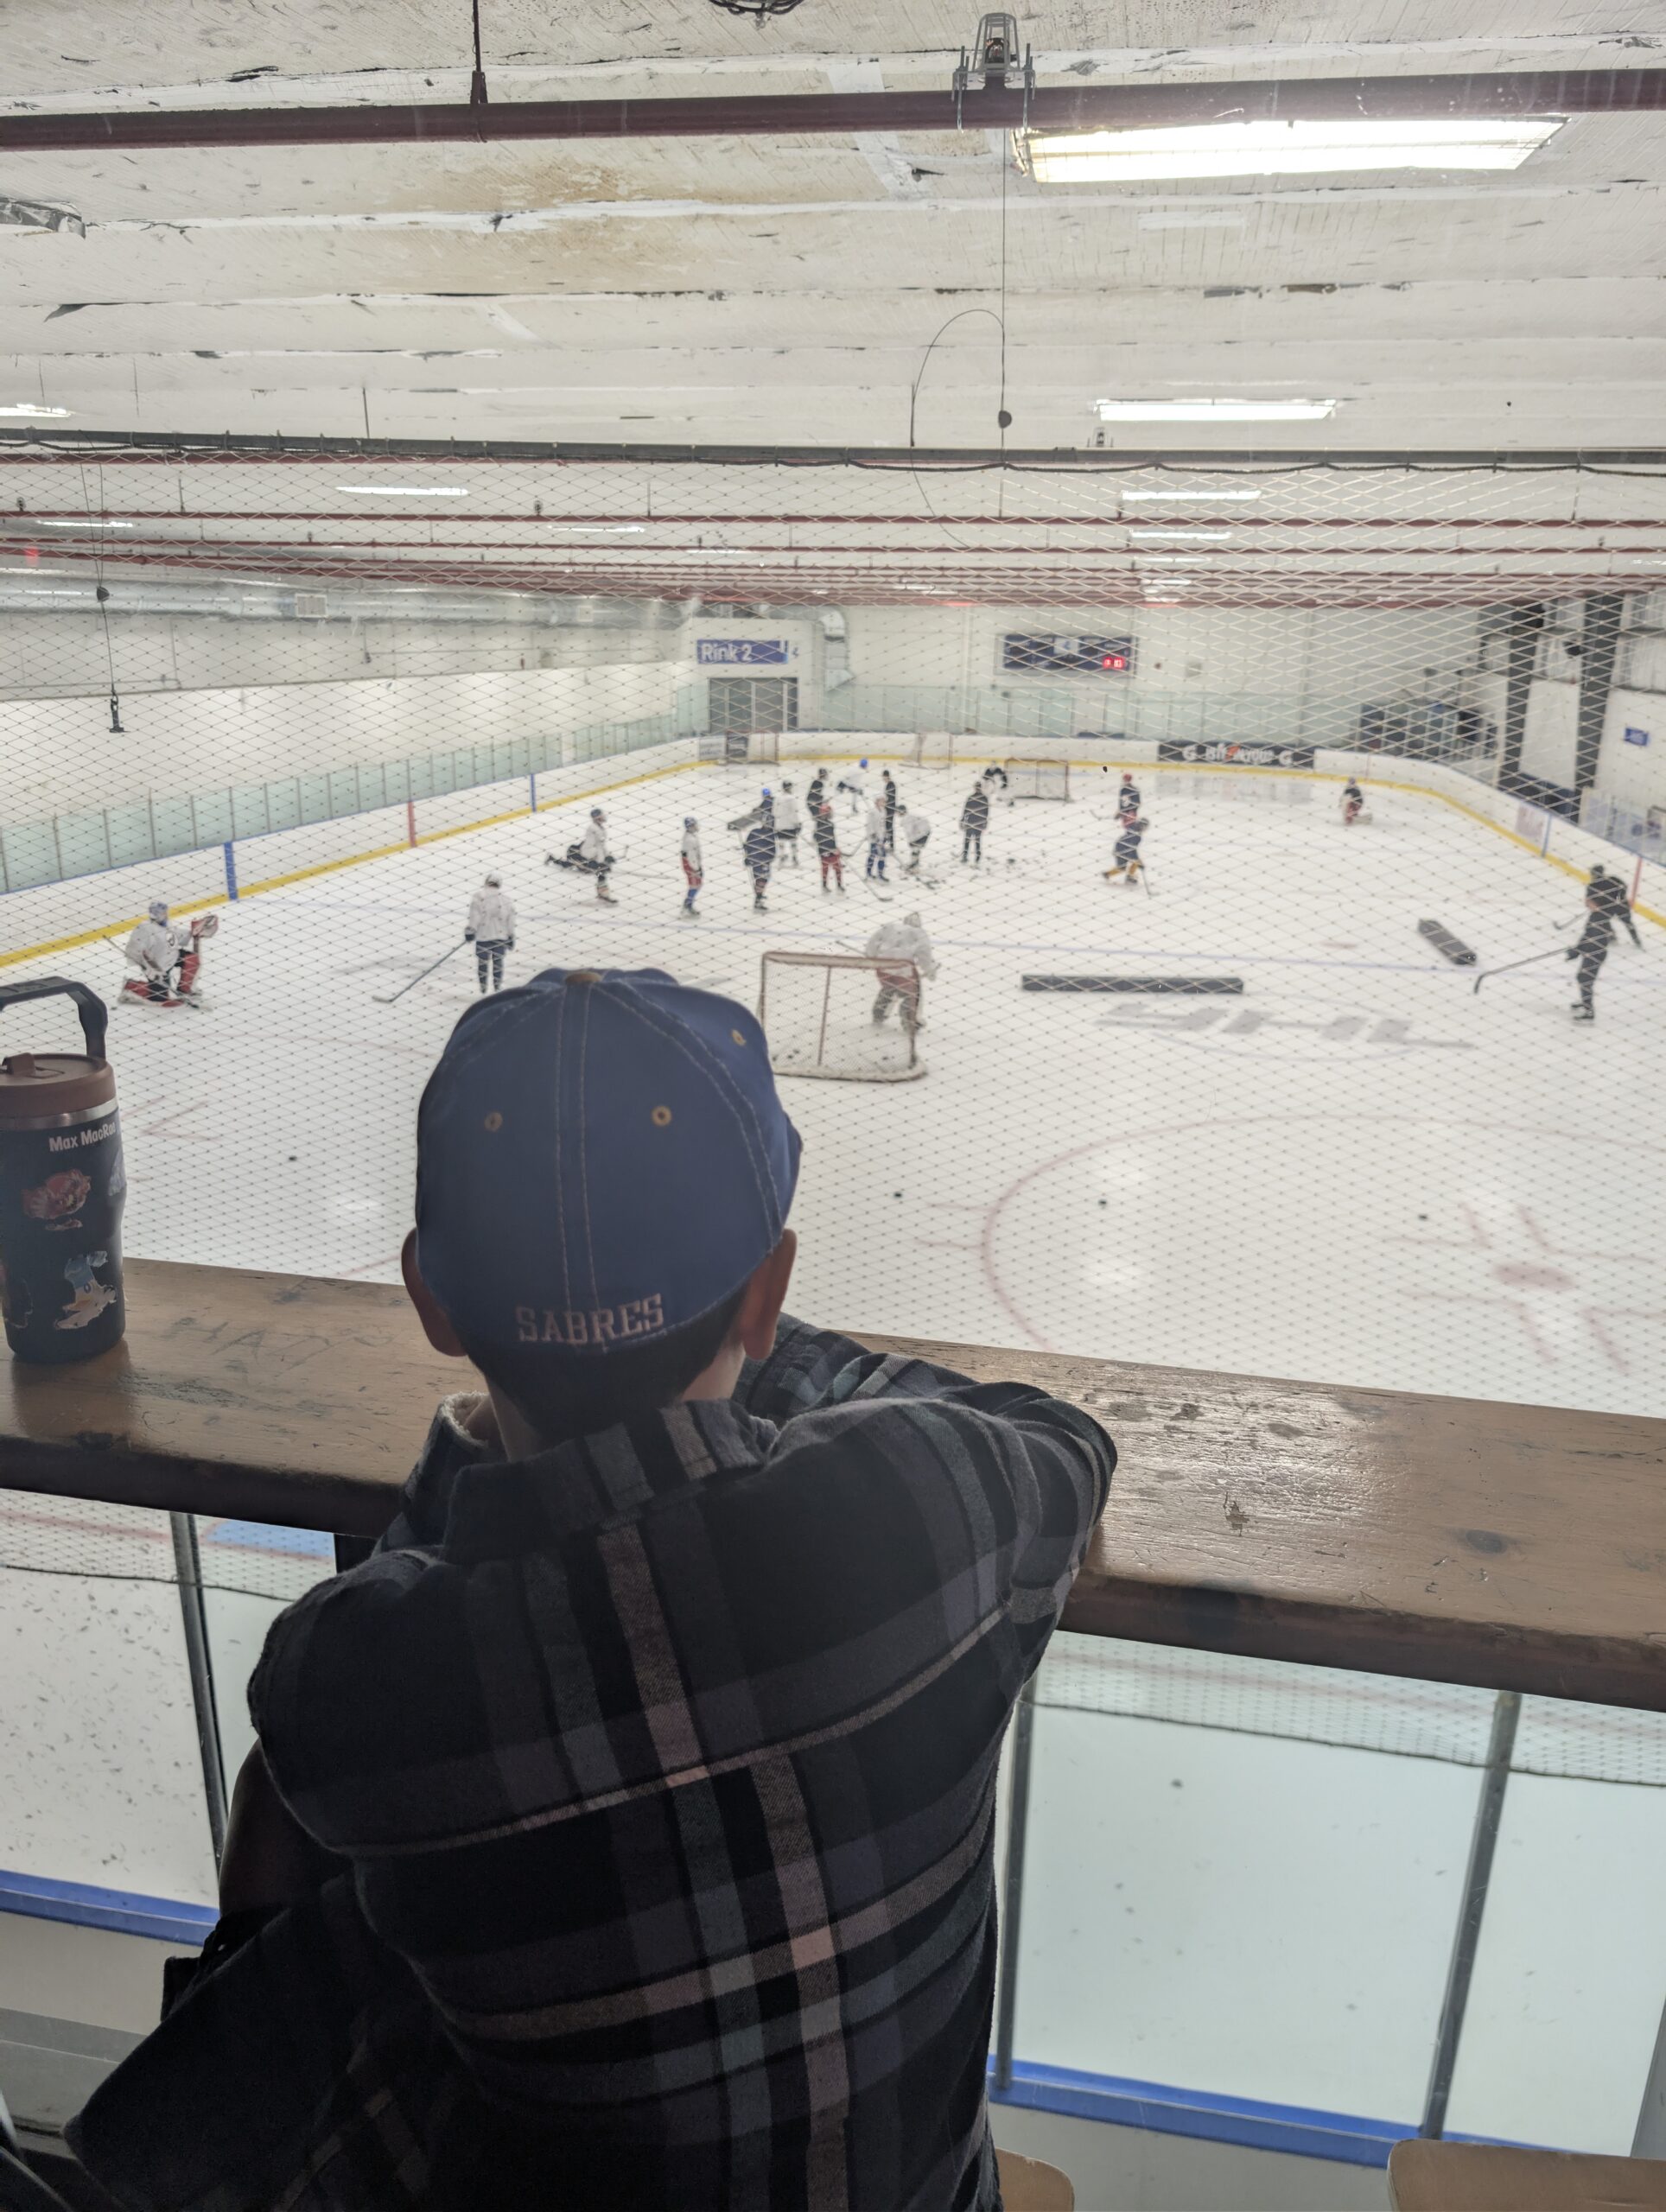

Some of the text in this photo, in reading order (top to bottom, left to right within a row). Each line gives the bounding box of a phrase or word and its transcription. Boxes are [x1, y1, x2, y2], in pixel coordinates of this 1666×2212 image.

[701, 643, 753, 662] Rink 2
[48, 1135, 79, 1152] Max
[516, 1293, 664, 1344] SABRES
